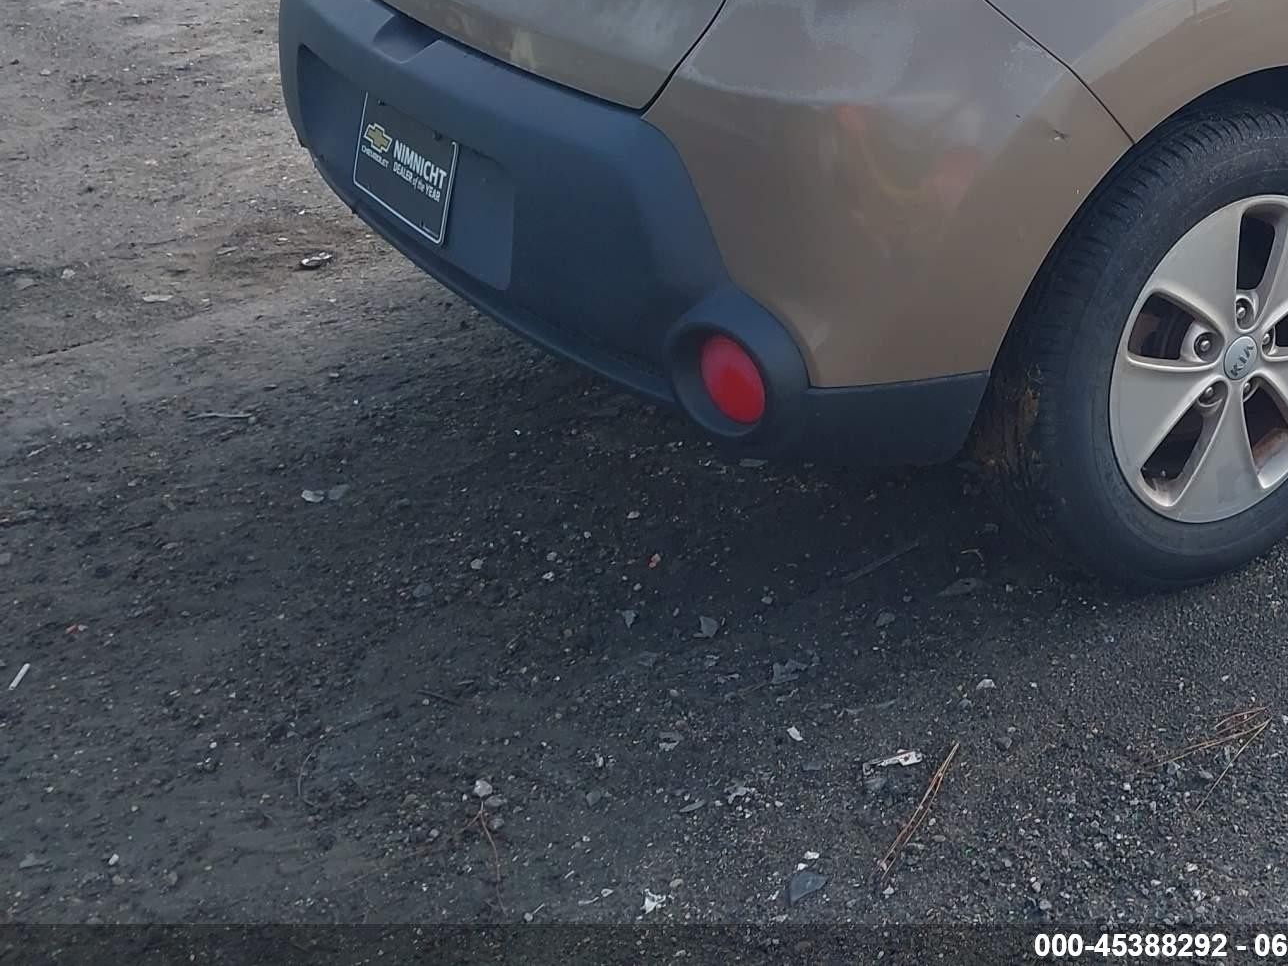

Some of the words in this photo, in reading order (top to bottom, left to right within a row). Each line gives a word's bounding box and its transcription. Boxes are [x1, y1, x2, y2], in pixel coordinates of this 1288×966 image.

[393, 139, 447, 189] NIMNICHT
[393, 161, 413, 183] DEALER
[425, 183, 441, 202] YEAR
[1230, 345, 1255, 376] KIA
